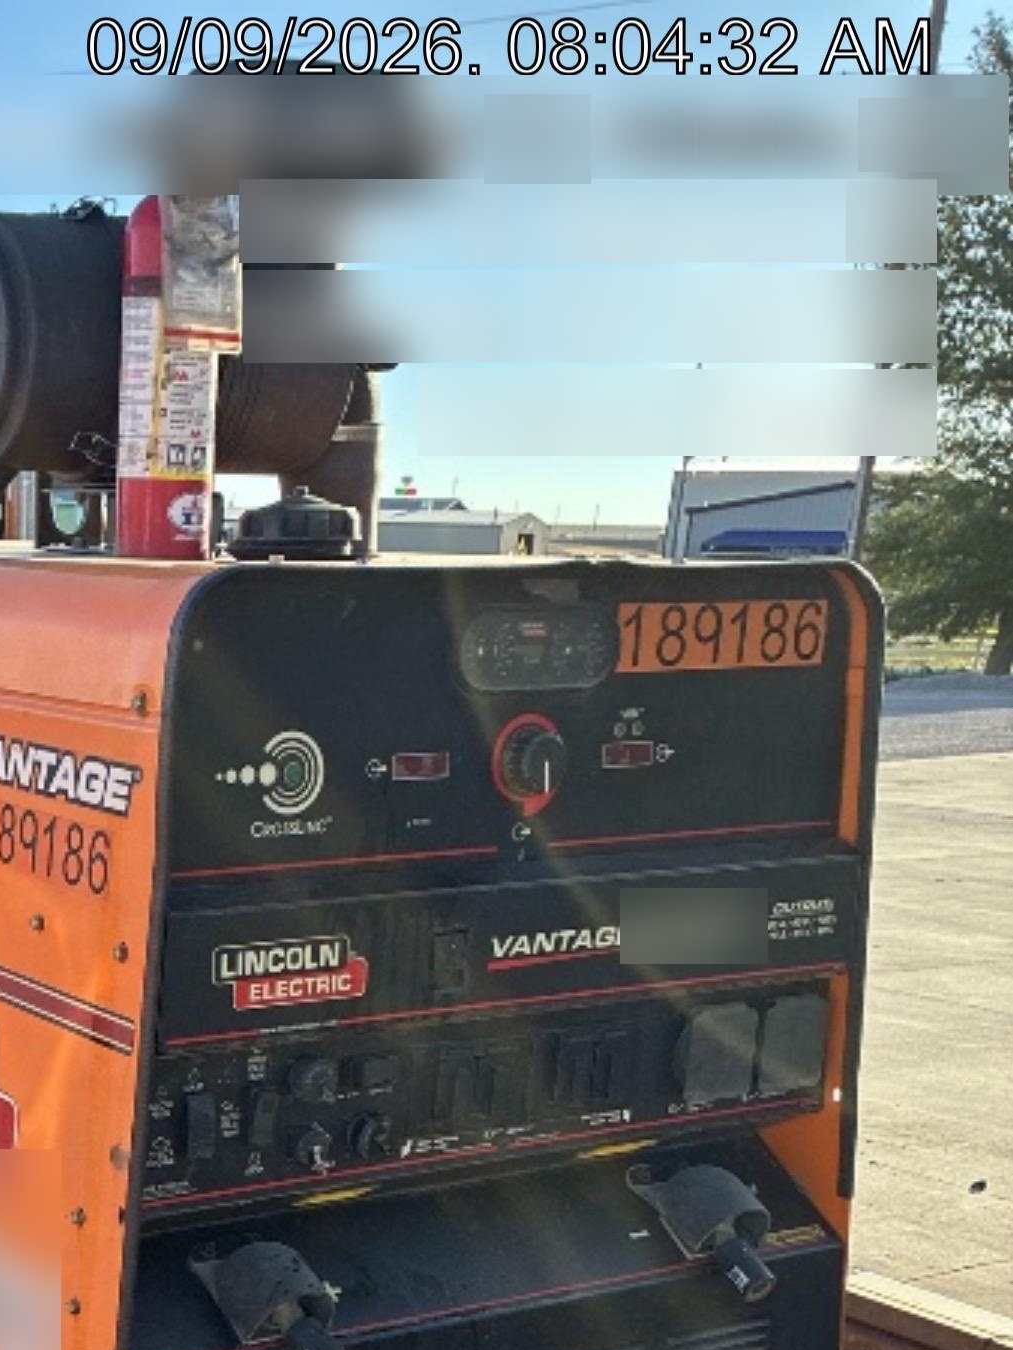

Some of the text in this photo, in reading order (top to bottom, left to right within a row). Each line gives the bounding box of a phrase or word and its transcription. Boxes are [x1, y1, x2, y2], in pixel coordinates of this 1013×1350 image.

[623, 601, 822, 667] 189186
[491, 926, 620, 957] VANTAG
[220, 941, 340, 979] LINCOLN
[250, 974, 352, 1001] ELECTRIC
